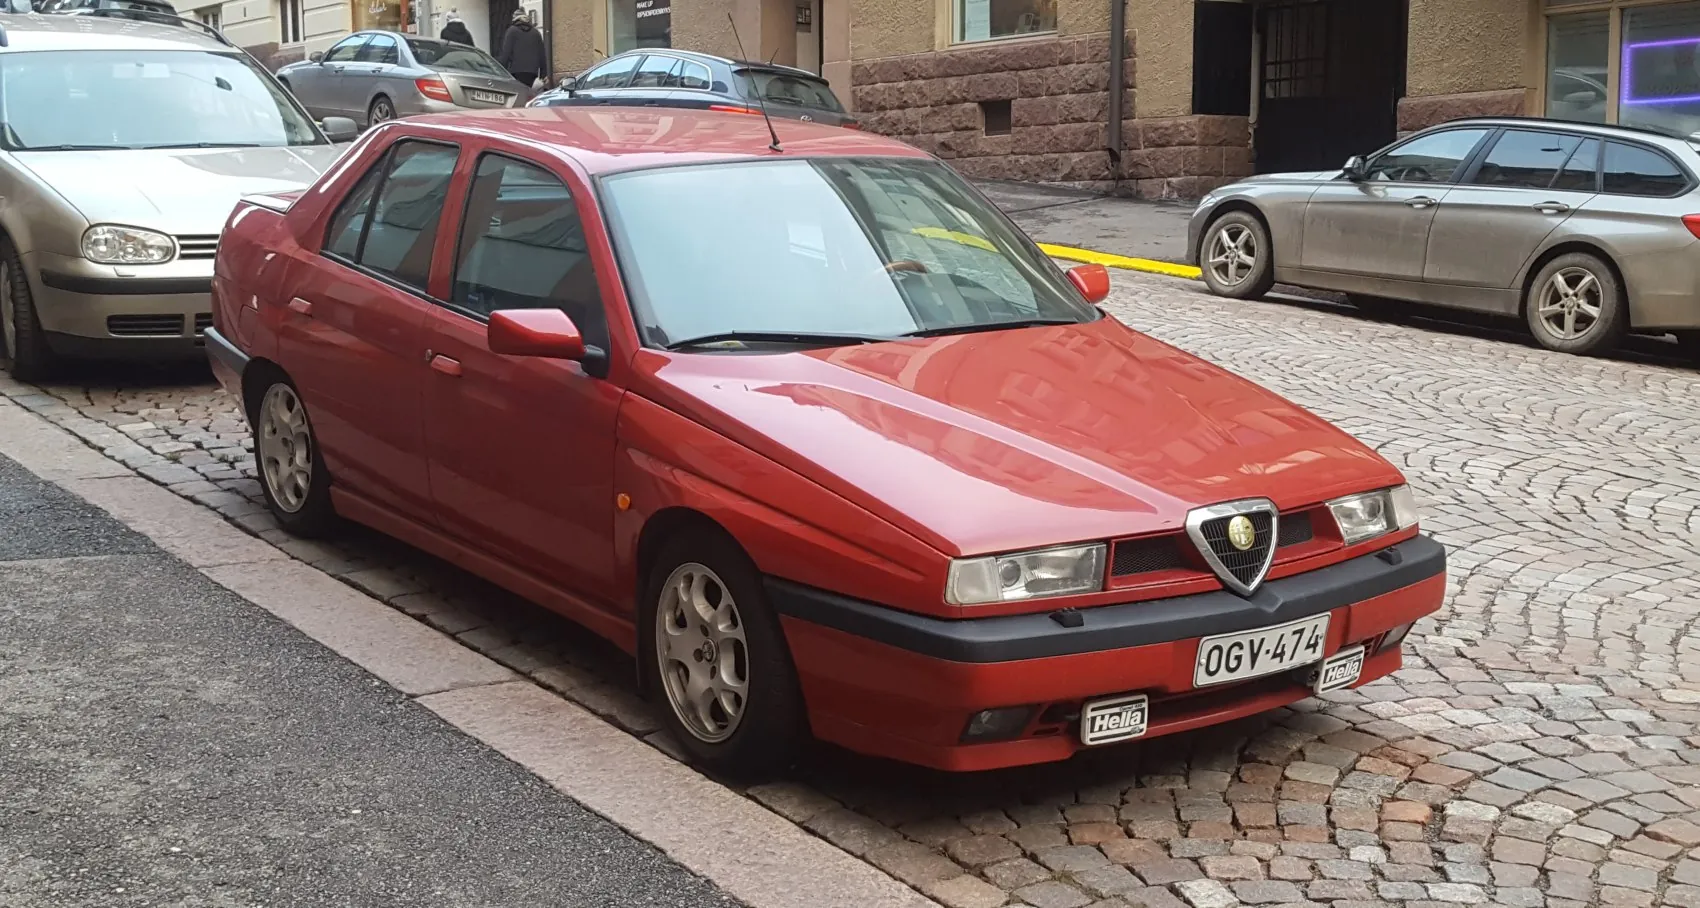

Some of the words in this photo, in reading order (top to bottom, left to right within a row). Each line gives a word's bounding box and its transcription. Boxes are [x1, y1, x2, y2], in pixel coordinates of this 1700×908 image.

[1205, 624, 1319, 677] OGV-474
[1325, 661, 1360, 683] Hella
[1094, 710, 1141, 732] Hella
